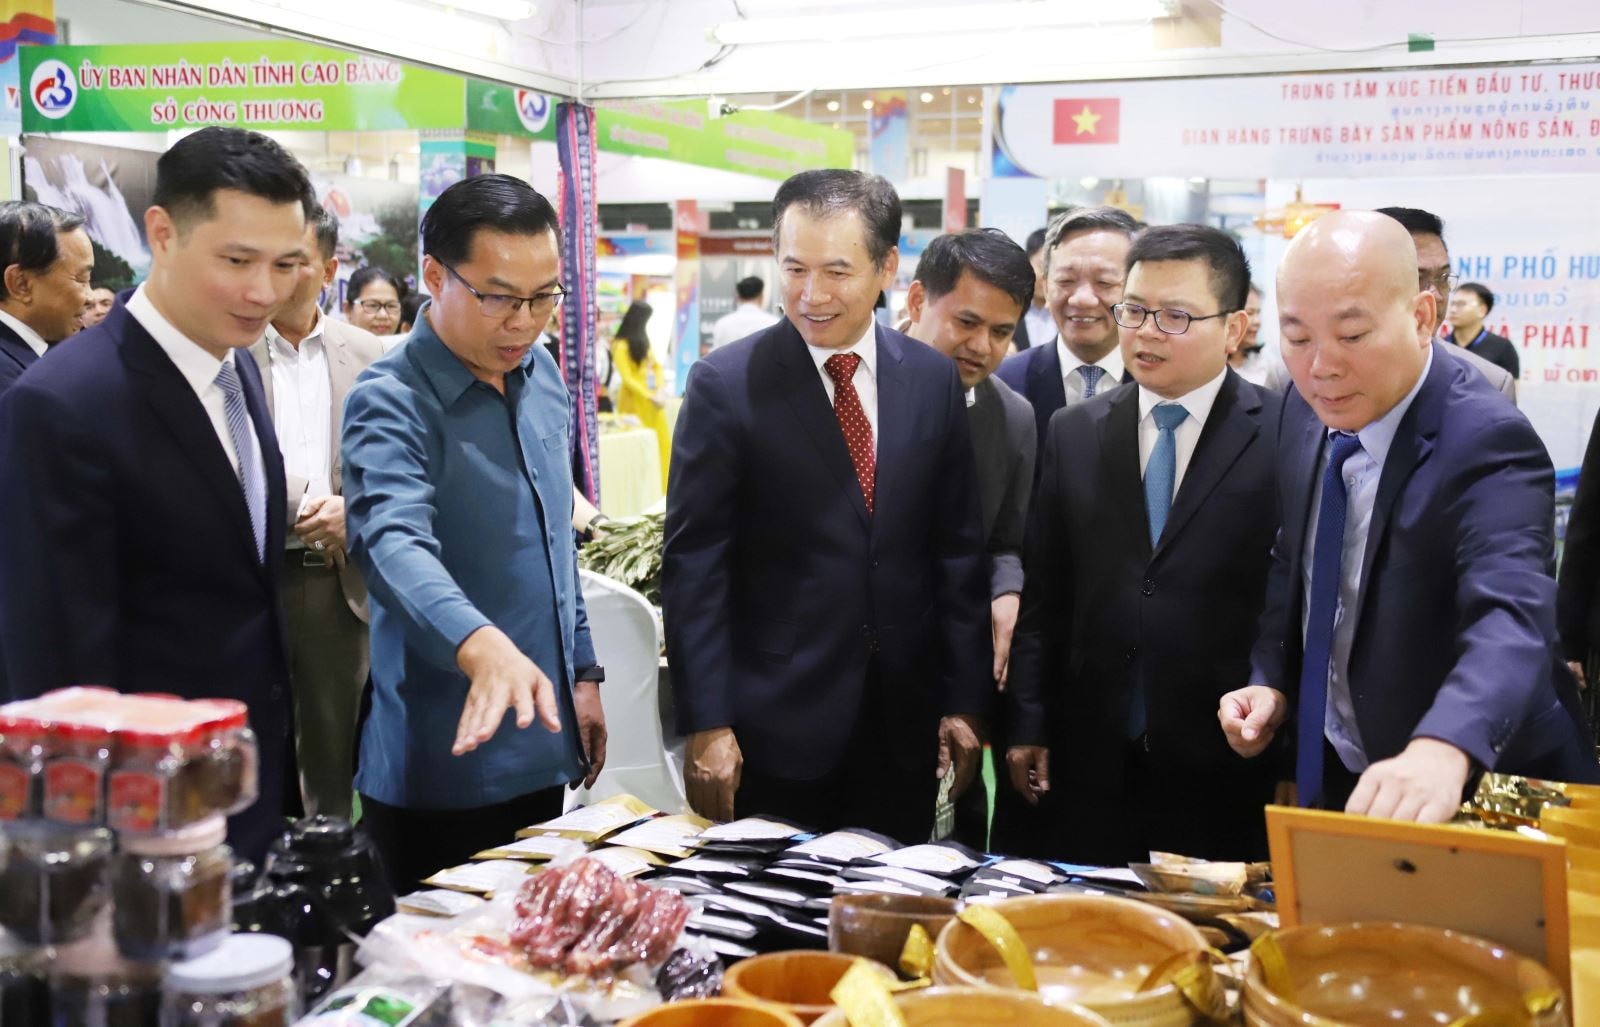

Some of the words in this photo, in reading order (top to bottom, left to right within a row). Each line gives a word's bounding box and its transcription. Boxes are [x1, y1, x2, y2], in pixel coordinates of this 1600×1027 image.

[80, 61, 103, 88] ỦY
[109, 67, 146, 88] BAN
[151, 60, 202, 88] NHÂN
[208, 59, 246, 87] DÂN
[252, 57, 295, 85] TỈNH
[301, 63, 340, 84] CAO
[1281, 82, 1335, 100] TRUNG
[1344, 79, 1378, 97] TÂM
[1387, 76, 1419, 97] XÚC
[153, 98, 176, 122] SỞ
[184, 97, 235, 122] CÔNG
[244, 101, 322, 121] THƯƠNG
[1182, 127, 1220, 145] GIAN
[1227, 125, 1271, 145] HÀNG
[1279, 126, 1333, 145] TRƯNG
[1340, 124, 1374, 144] BÀY
[1482, 118, 1530, 139] NÔNG
[1503, 246, 1557, 279] PHỐ
[1523, 317, 1590, 349] PHÁT
